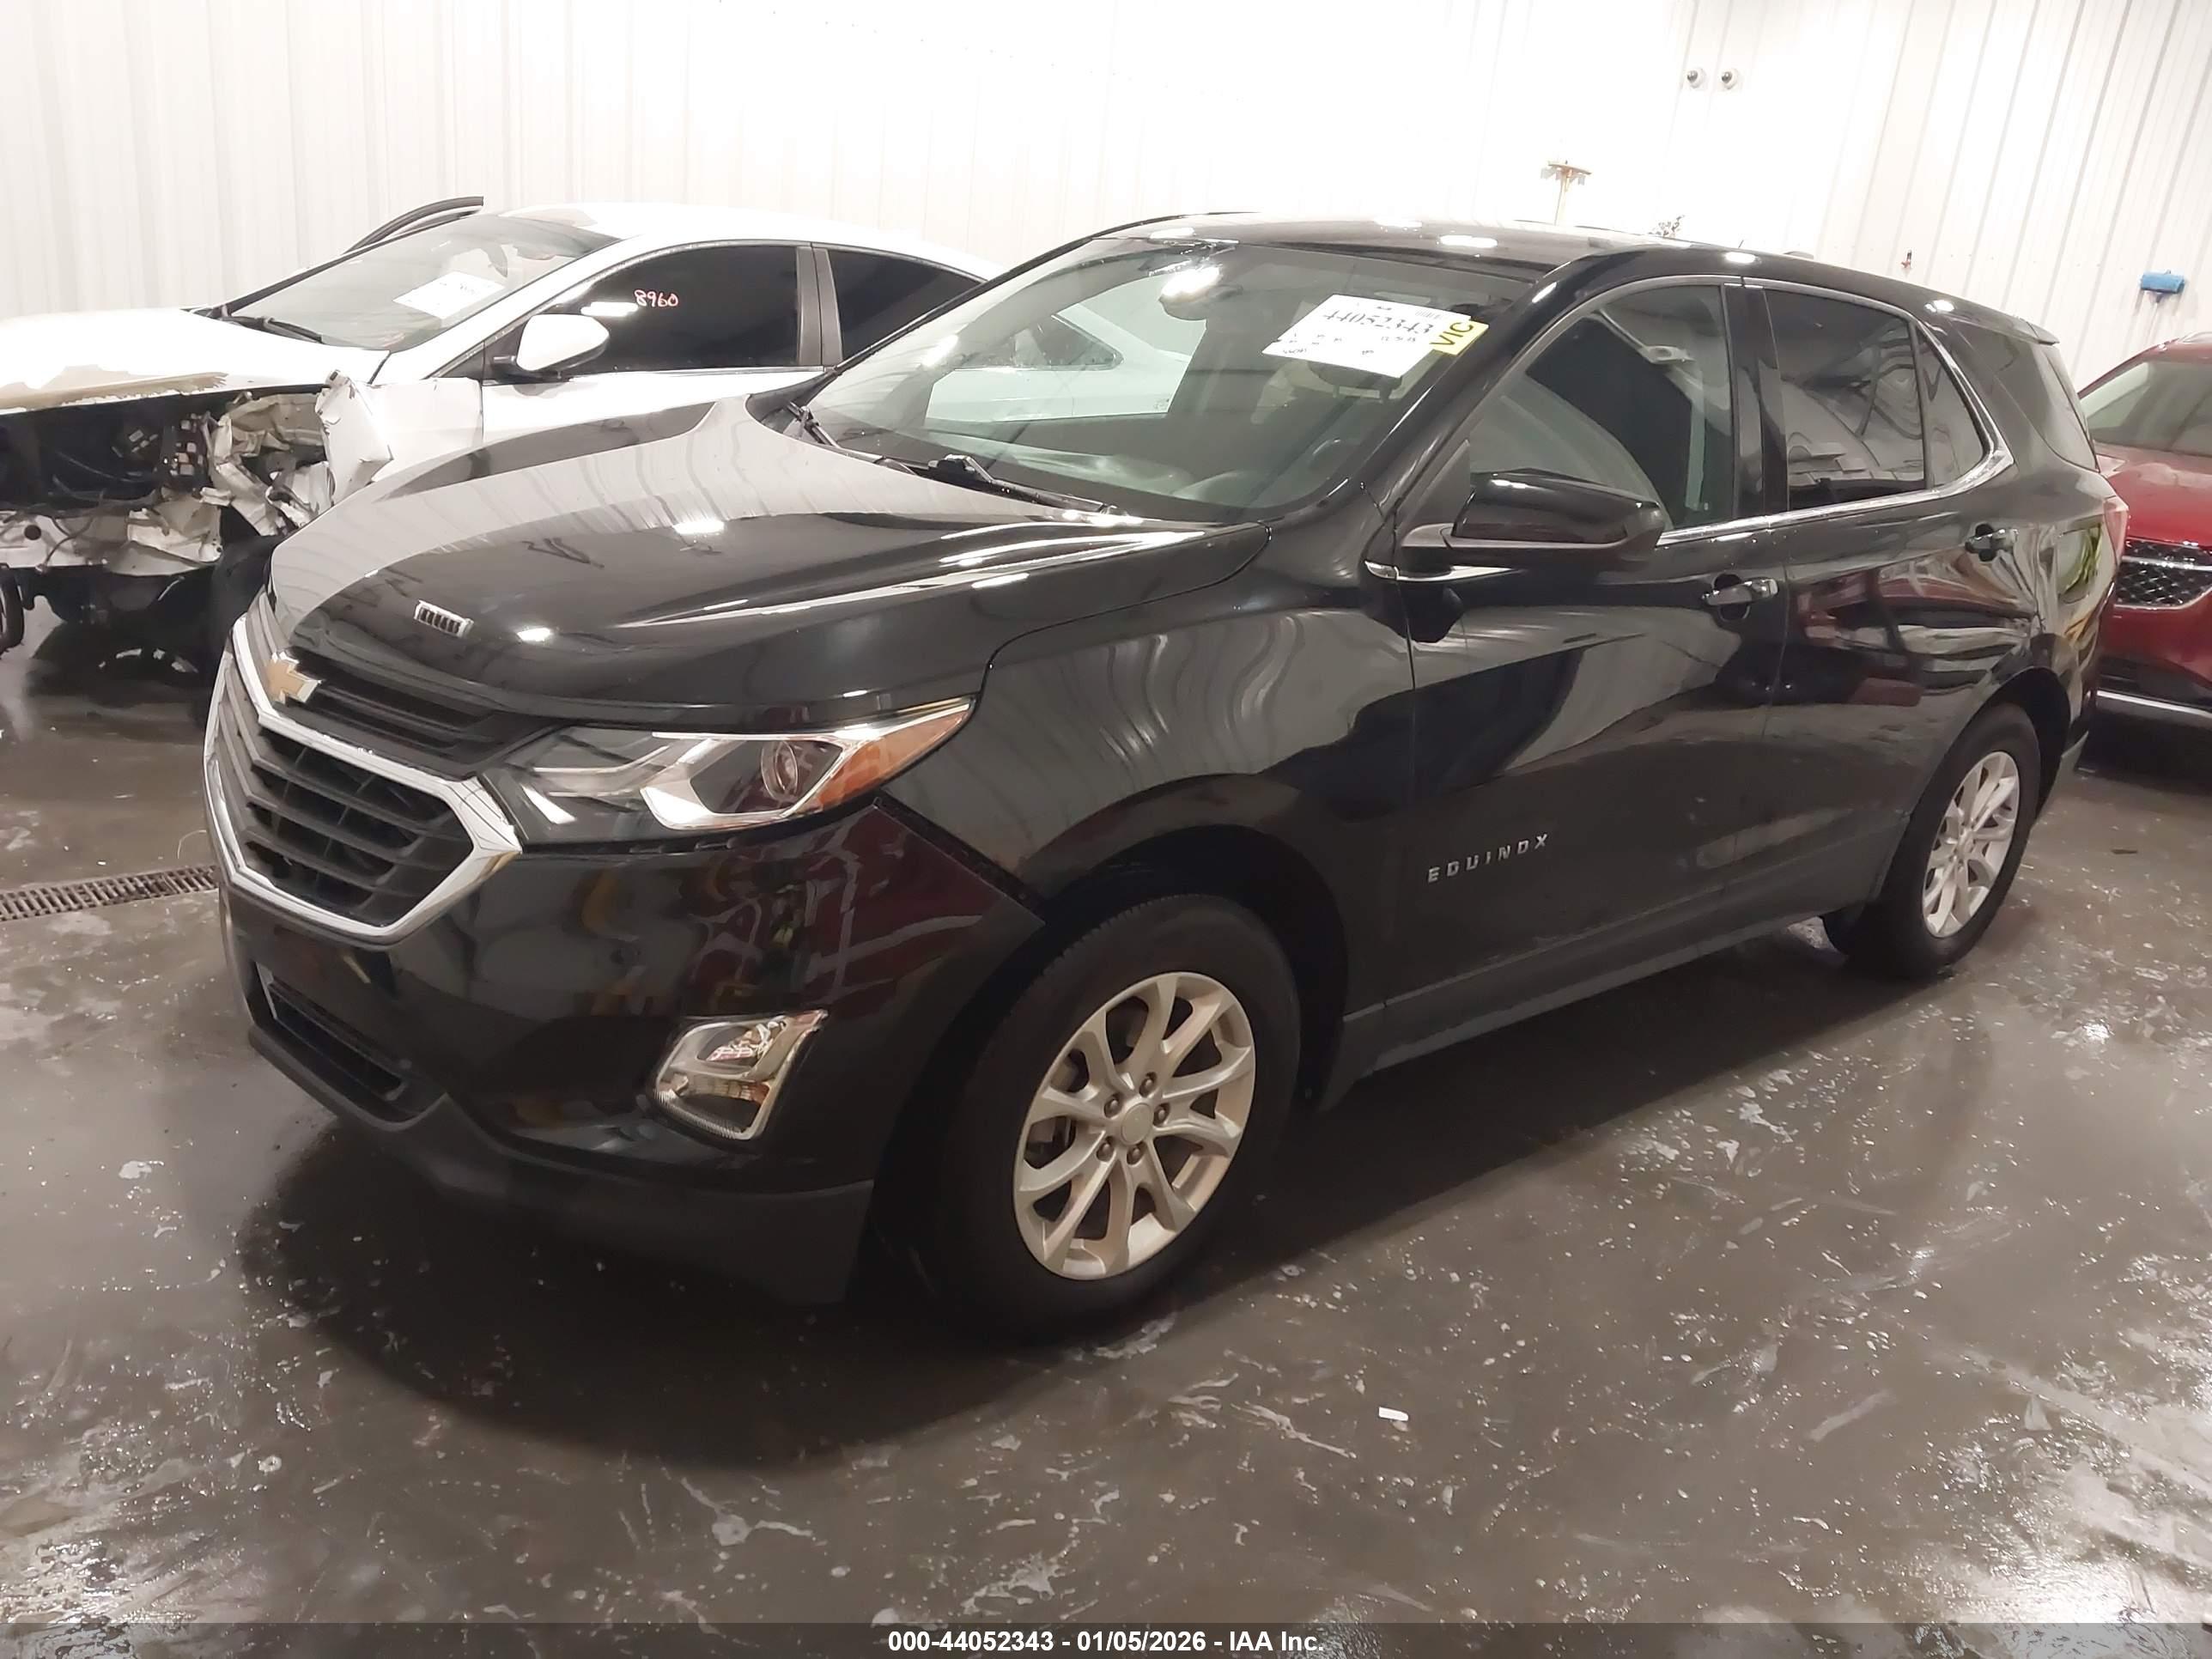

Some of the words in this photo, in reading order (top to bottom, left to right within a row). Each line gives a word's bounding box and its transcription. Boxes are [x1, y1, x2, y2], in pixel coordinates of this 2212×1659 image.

[634, 289, 678, 307] 8960
[1429, 320, 1474, 346] VIC
[1427, 833, 1547, 883] EQUINOX
